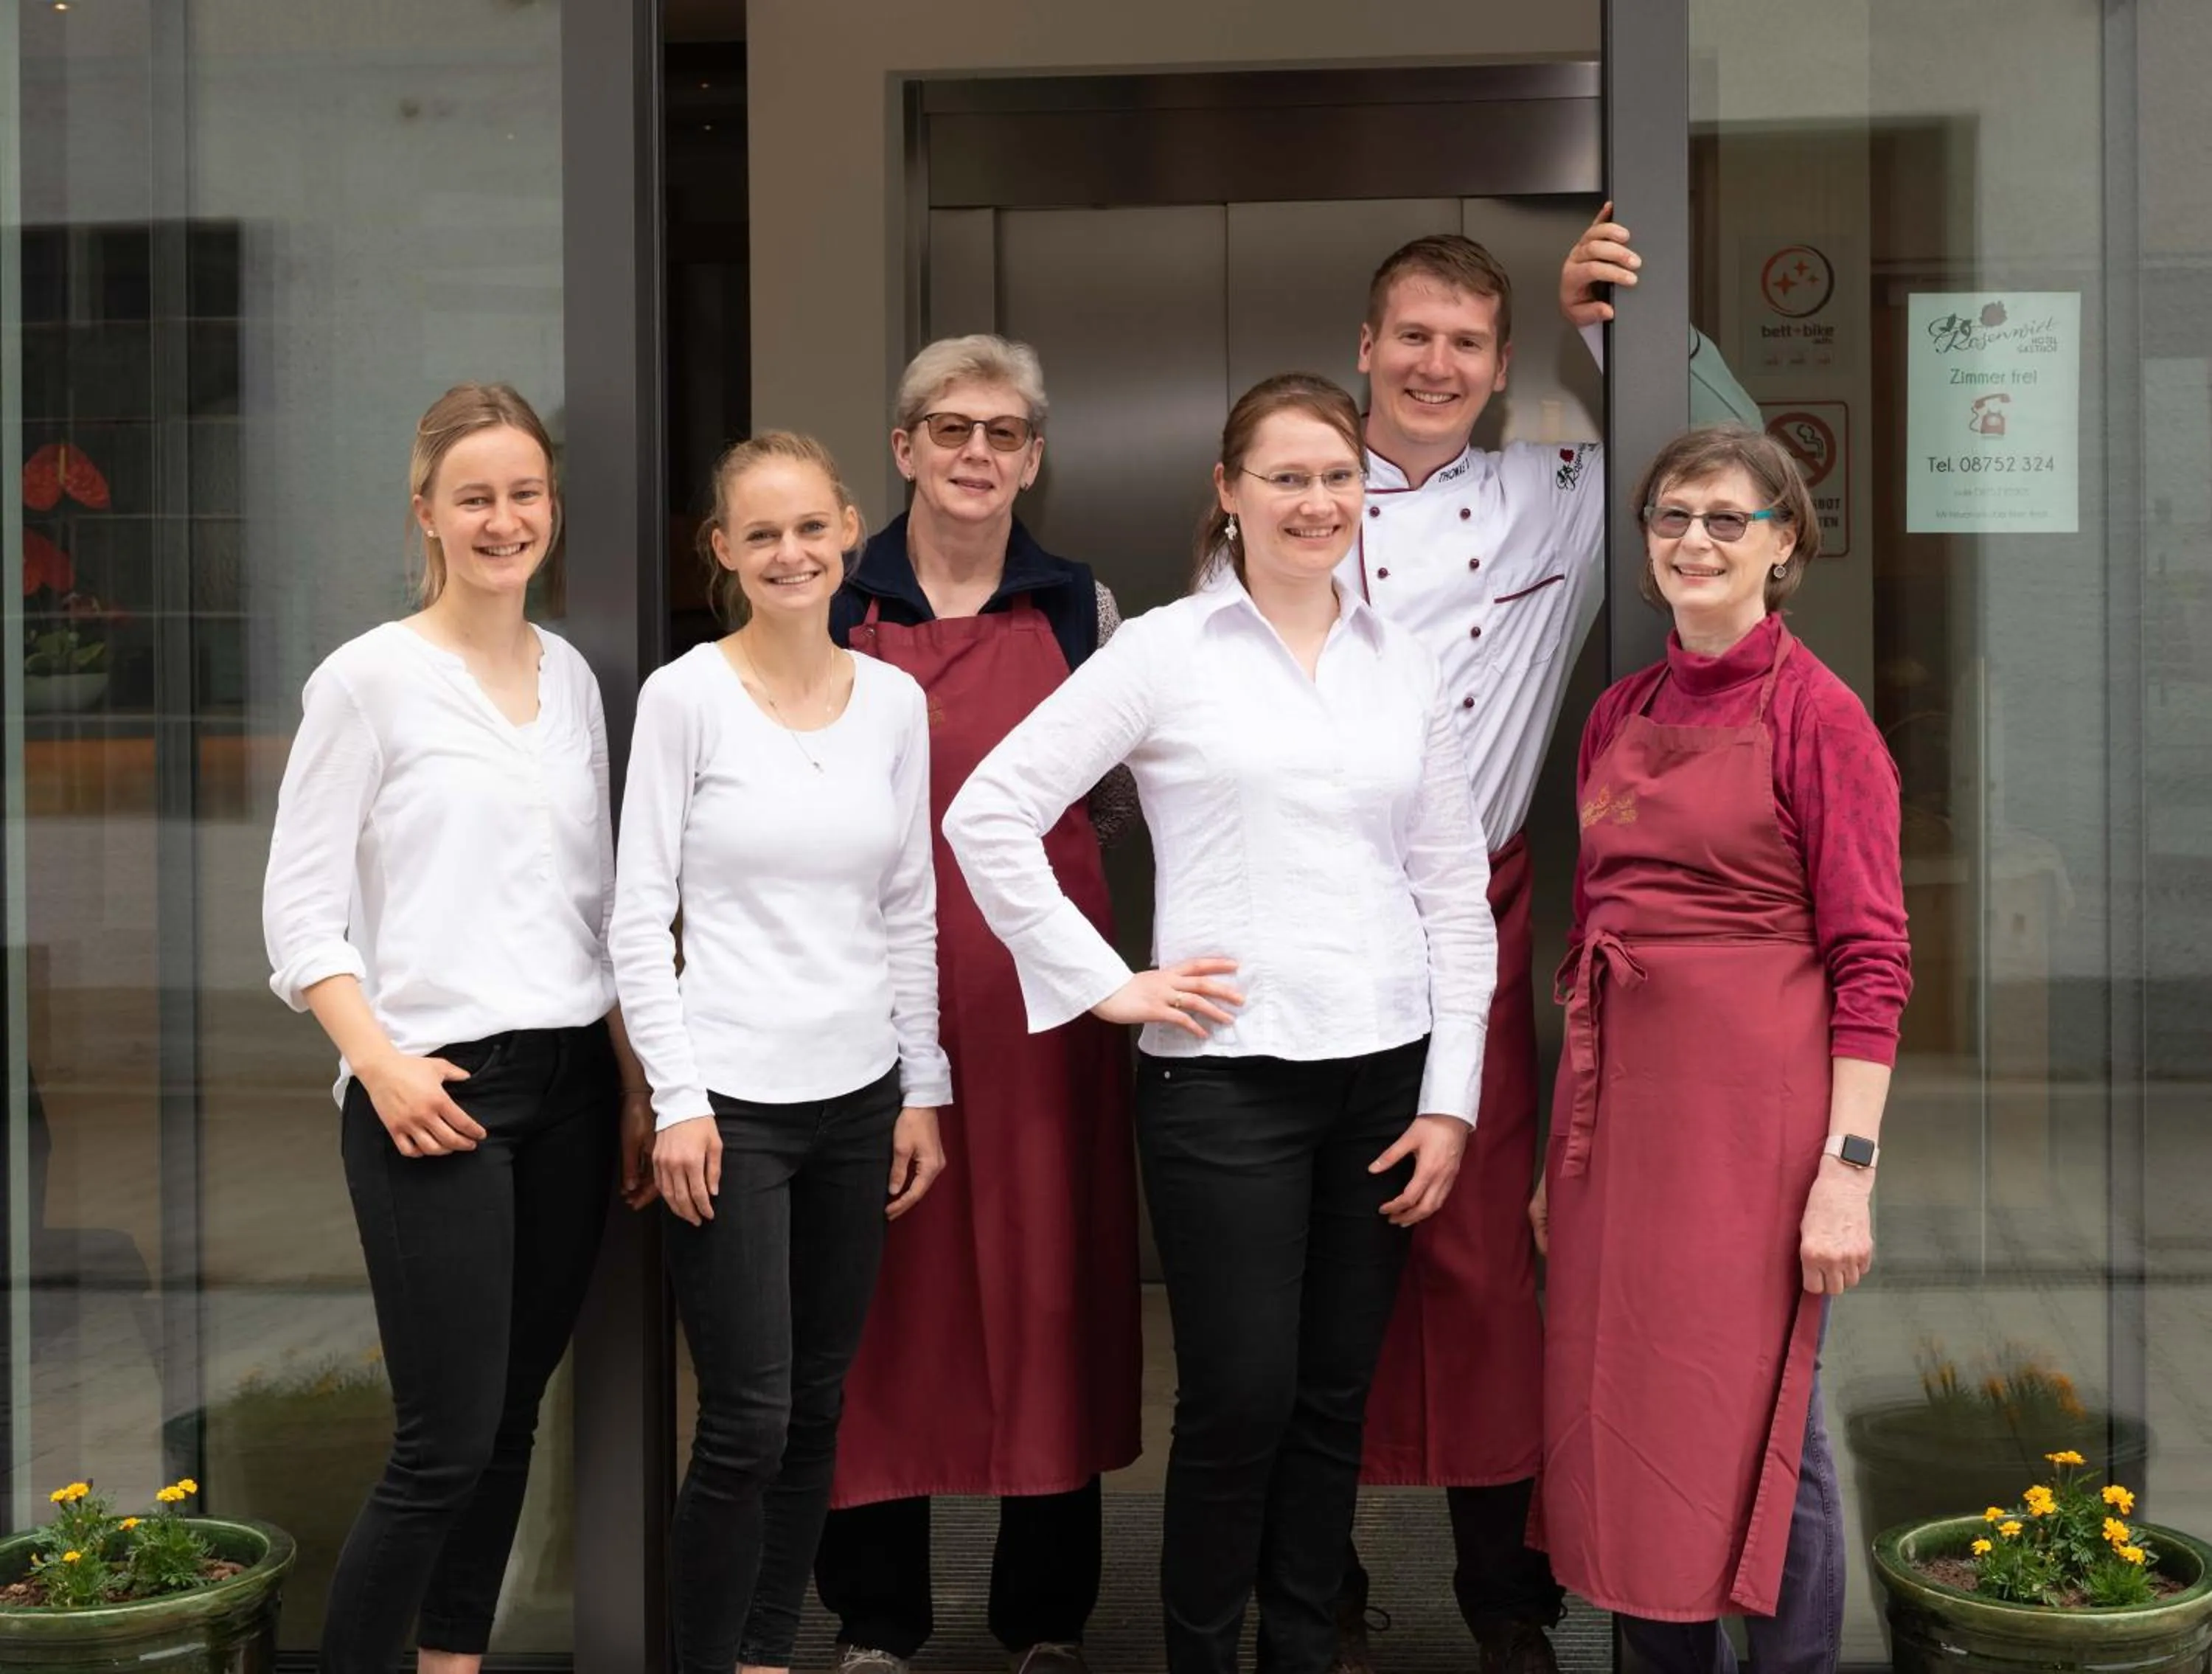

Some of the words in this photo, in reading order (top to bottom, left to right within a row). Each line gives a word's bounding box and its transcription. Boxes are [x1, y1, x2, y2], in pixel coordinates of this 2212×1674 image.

[1950, 368, 2006, 384] Zimmer
[2011, 369, 2038, 384] frei
[1927, 456, 1955, 473] Tel.
[1959, 456, 2017, 473] 08752
[2022, 455, 2055, 473] 324
